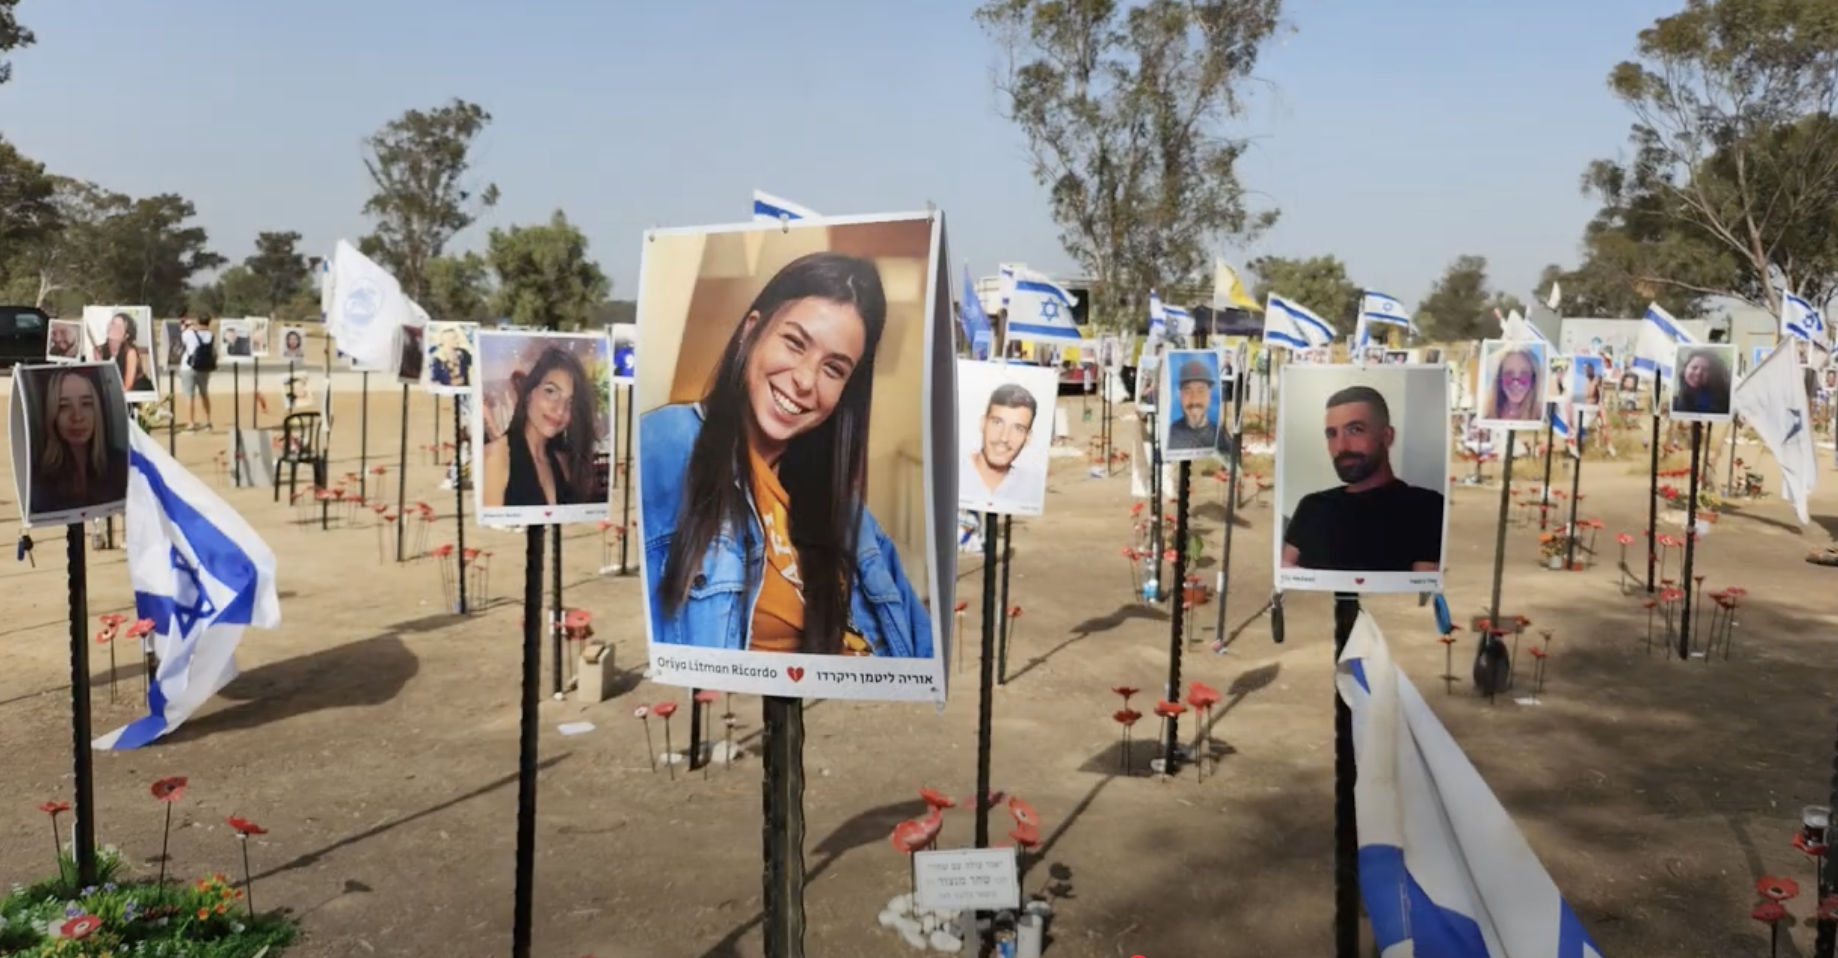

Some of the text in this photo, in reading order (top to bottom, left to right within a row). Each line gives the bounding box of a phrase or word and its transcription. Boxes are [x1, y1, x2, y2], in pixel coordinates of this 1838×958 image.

[657, 656, 778, 679] Oriya Litman Ricardo
[816, 670, 934, 684] אוריה ליטמן ריקרדו
